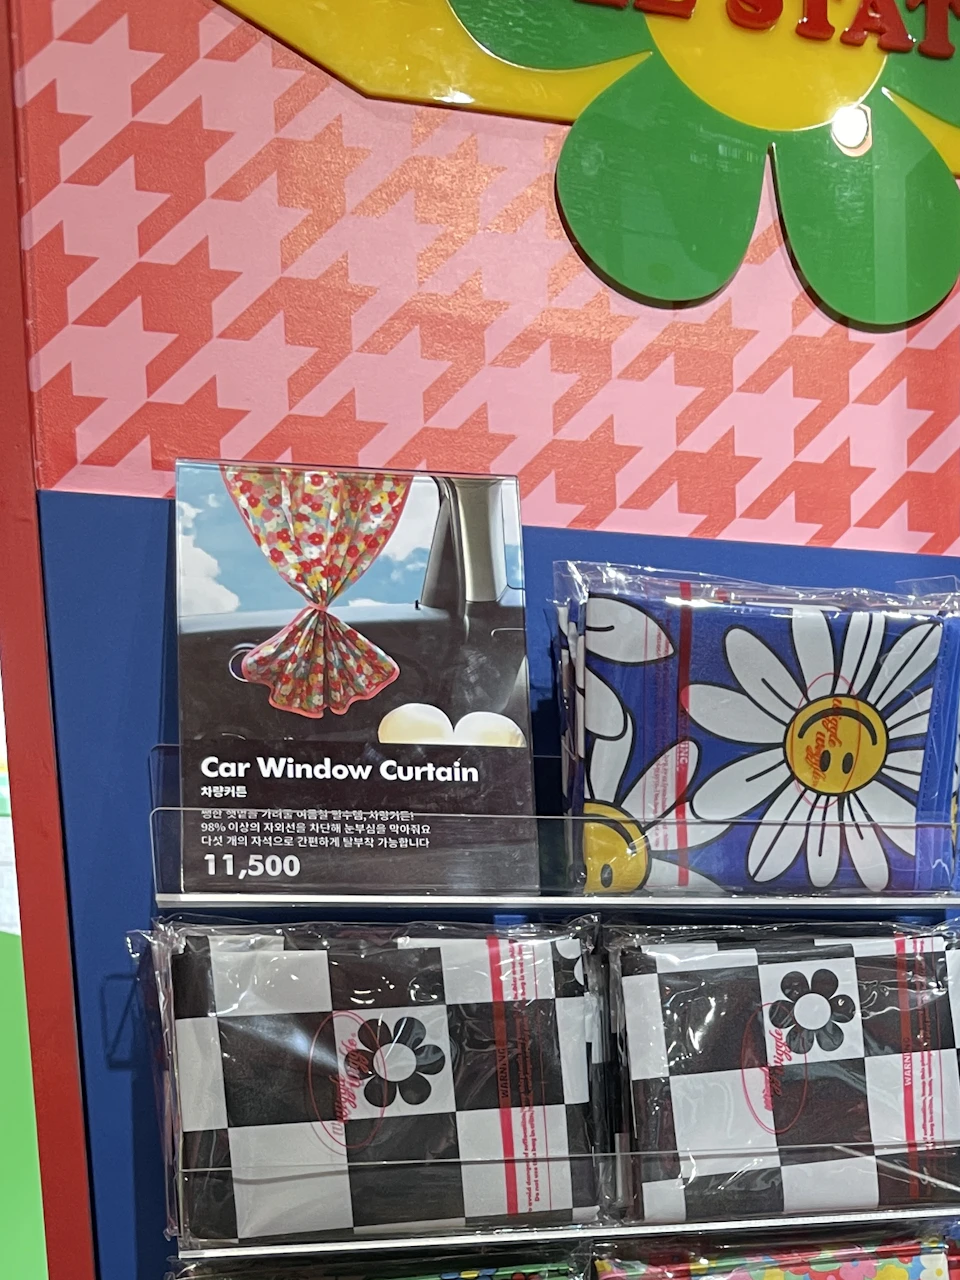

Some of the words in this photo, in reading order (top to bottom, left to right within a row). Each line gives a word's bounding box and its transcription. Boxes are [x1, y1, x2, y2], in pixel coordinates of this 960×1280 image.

[200, 755, 250, 779] Car
[256, 756, 372, 781] Window
[379, 757, 480, 783] Curtain
[200, 785, 248, 798] 차량커튼
[200, 822, 226, 832] 98%
[228, 821, 261, 833] 이상의
[263, 822, 307, 833] 자외선을
[309, 822, 342, 834] 차단해
[344, 823, 386, 834] 눈부심을
[389, 824, 431, 835] 막아줘요
[201, 835, 223, 847] 다섯
[226, 835, 248, 847] 개의
[251, 836, 295, 847] 자석으로
[297, 836, 340, 848] 간편하게
[343, 837, 374, 848] 탈부착
[377, 837, 430, 849] 가능합니다
[203, 853, 301, 881] 11,500
